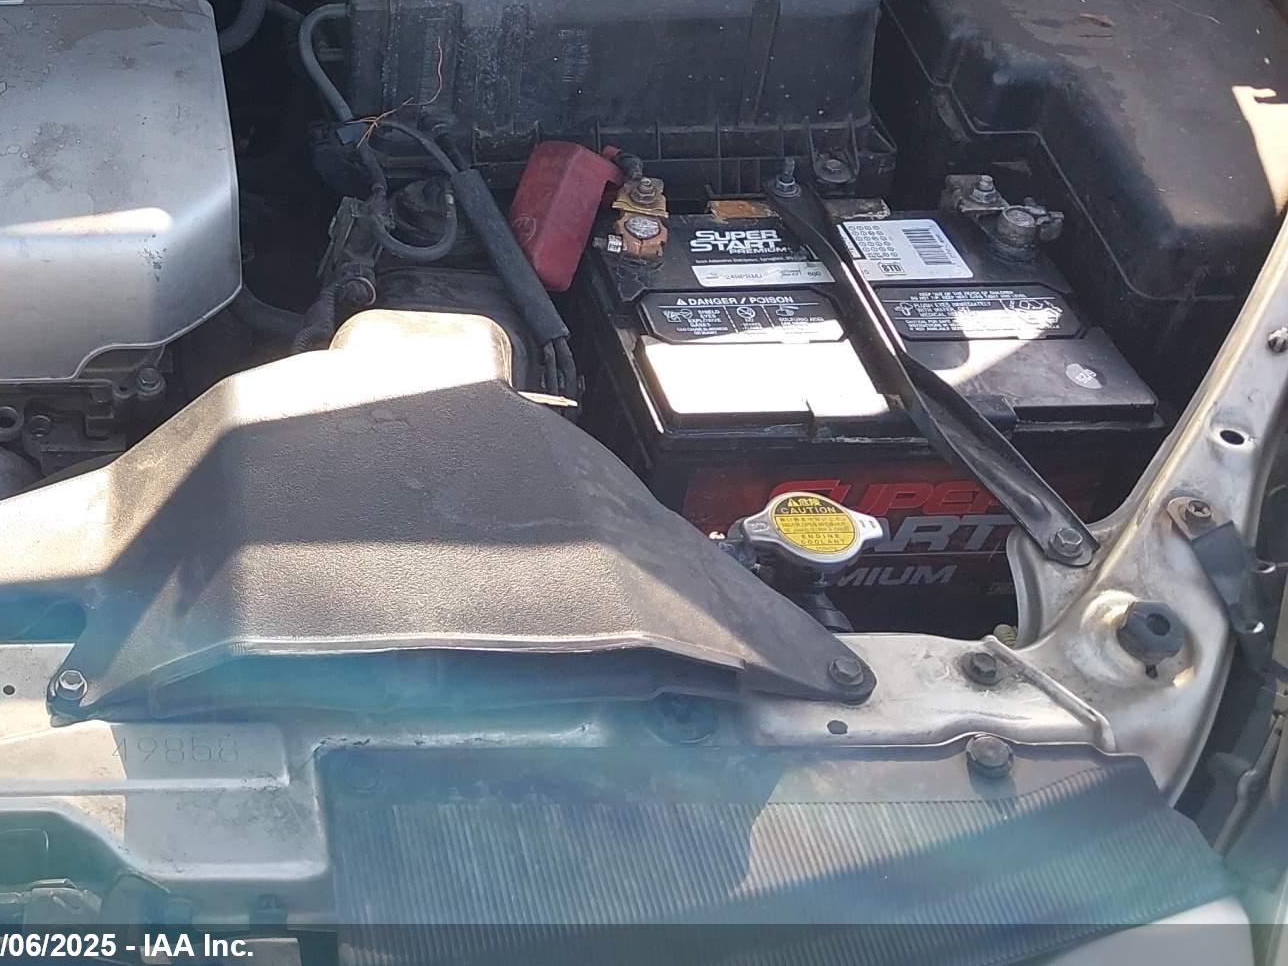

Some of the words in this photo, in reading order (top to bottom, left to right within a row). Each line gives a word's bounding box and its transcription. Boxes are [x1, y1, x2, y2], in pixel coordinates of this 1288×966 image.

[695, 229, 779, 241] SUPER
[689, 238, 782, 253] START
[728, 246, 787, 255] PREMIUM
[688, 297, 737, 306] DANGER
[749, 296, 795, 305] POISON
[780, 506, 837, 514] CAUTION
